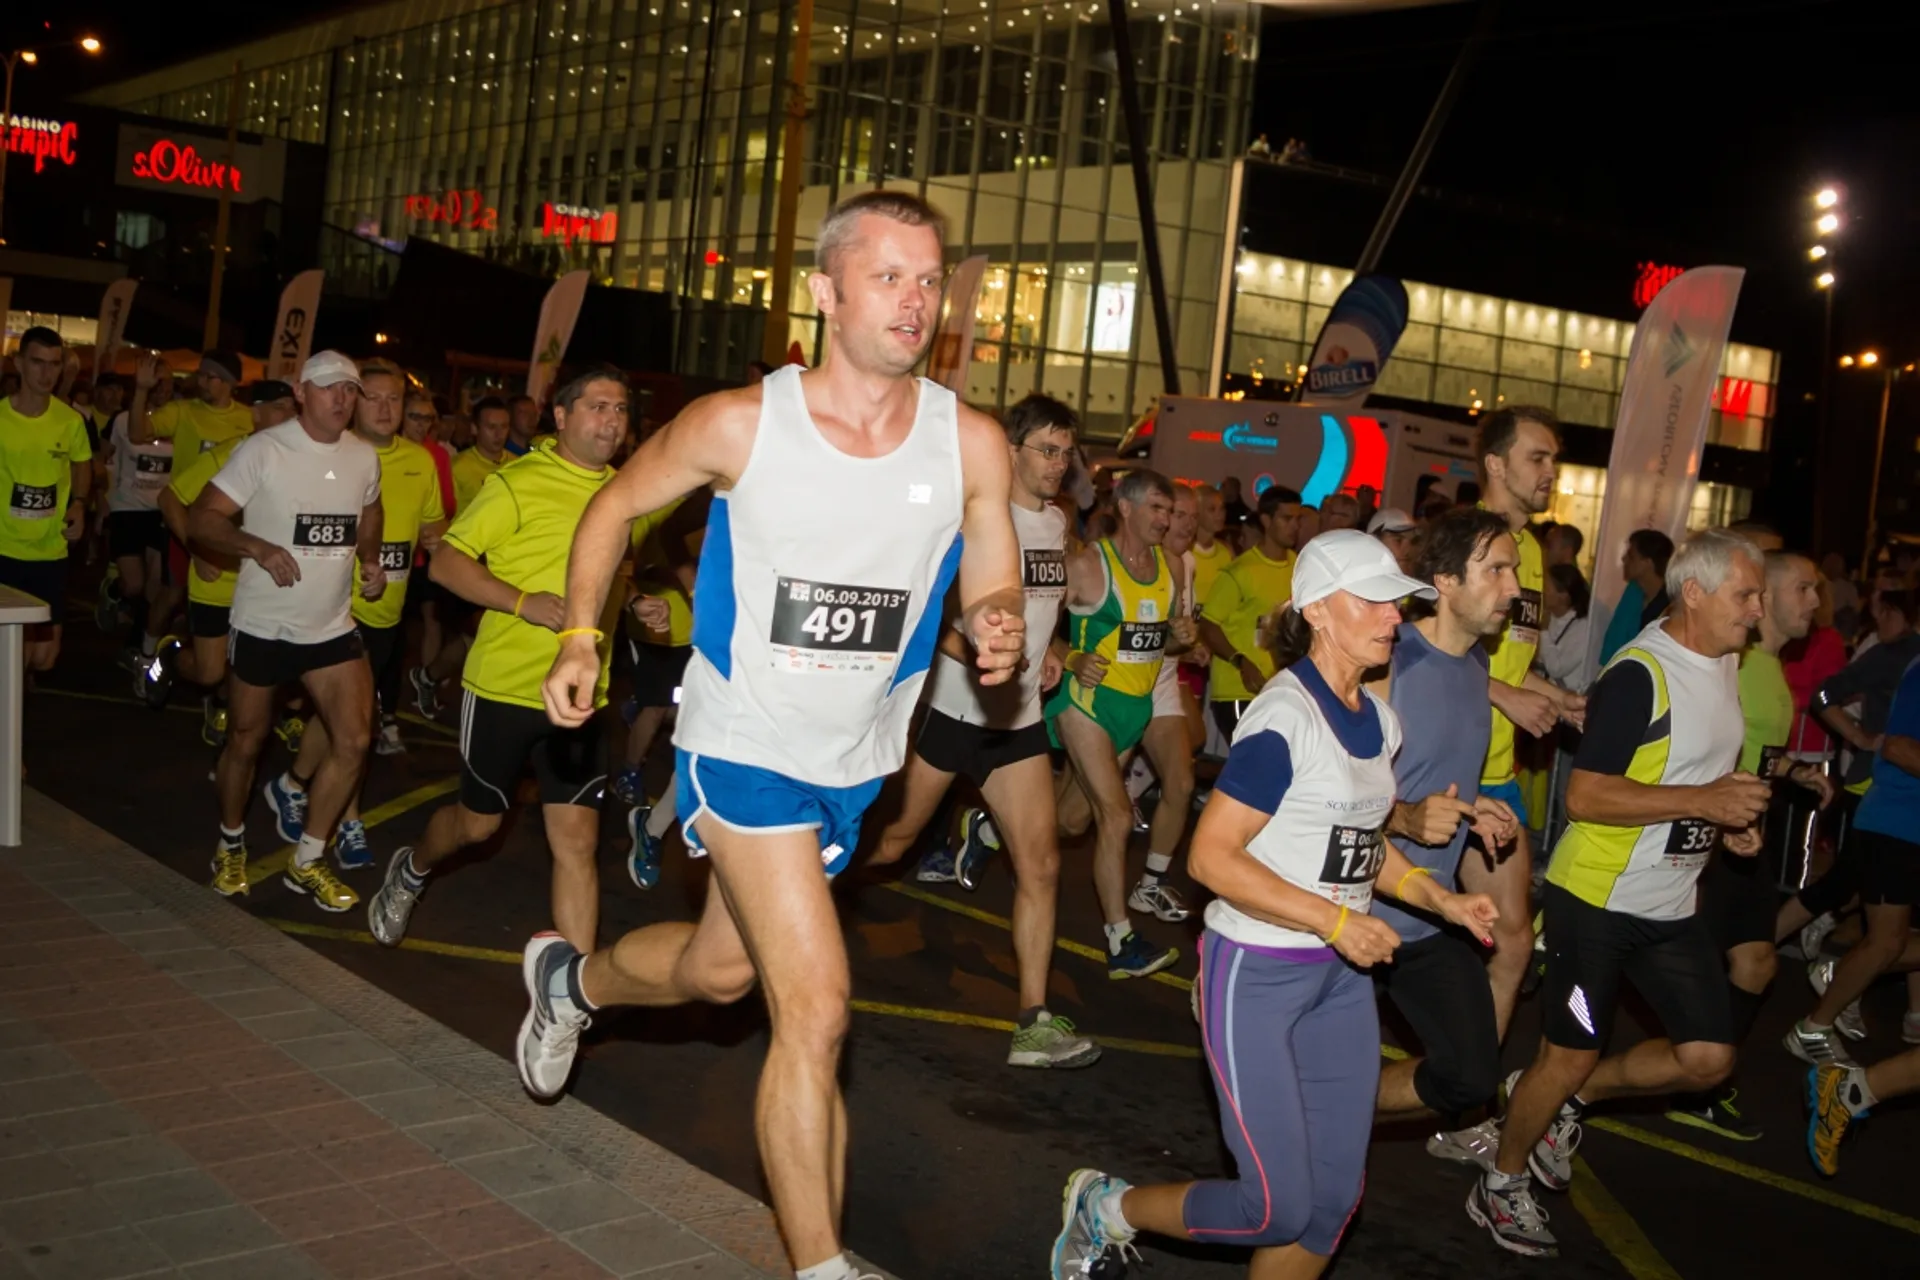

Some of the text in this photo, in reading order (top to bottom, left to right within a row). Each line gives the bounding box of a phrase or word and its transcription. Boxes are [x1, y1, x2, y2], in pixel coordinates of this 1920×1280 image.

[1310, 367, 1373, 390] BIRELL
[21, 492, 52, 508] 526
[308, 525, 345, 543] 683
[1030, 562, 1065, 583] 1050
[814, 587, 900, 608] 06.09.2013
[801, 605, 877, 644] 491
[1131, 632, 1162, 648] 678
